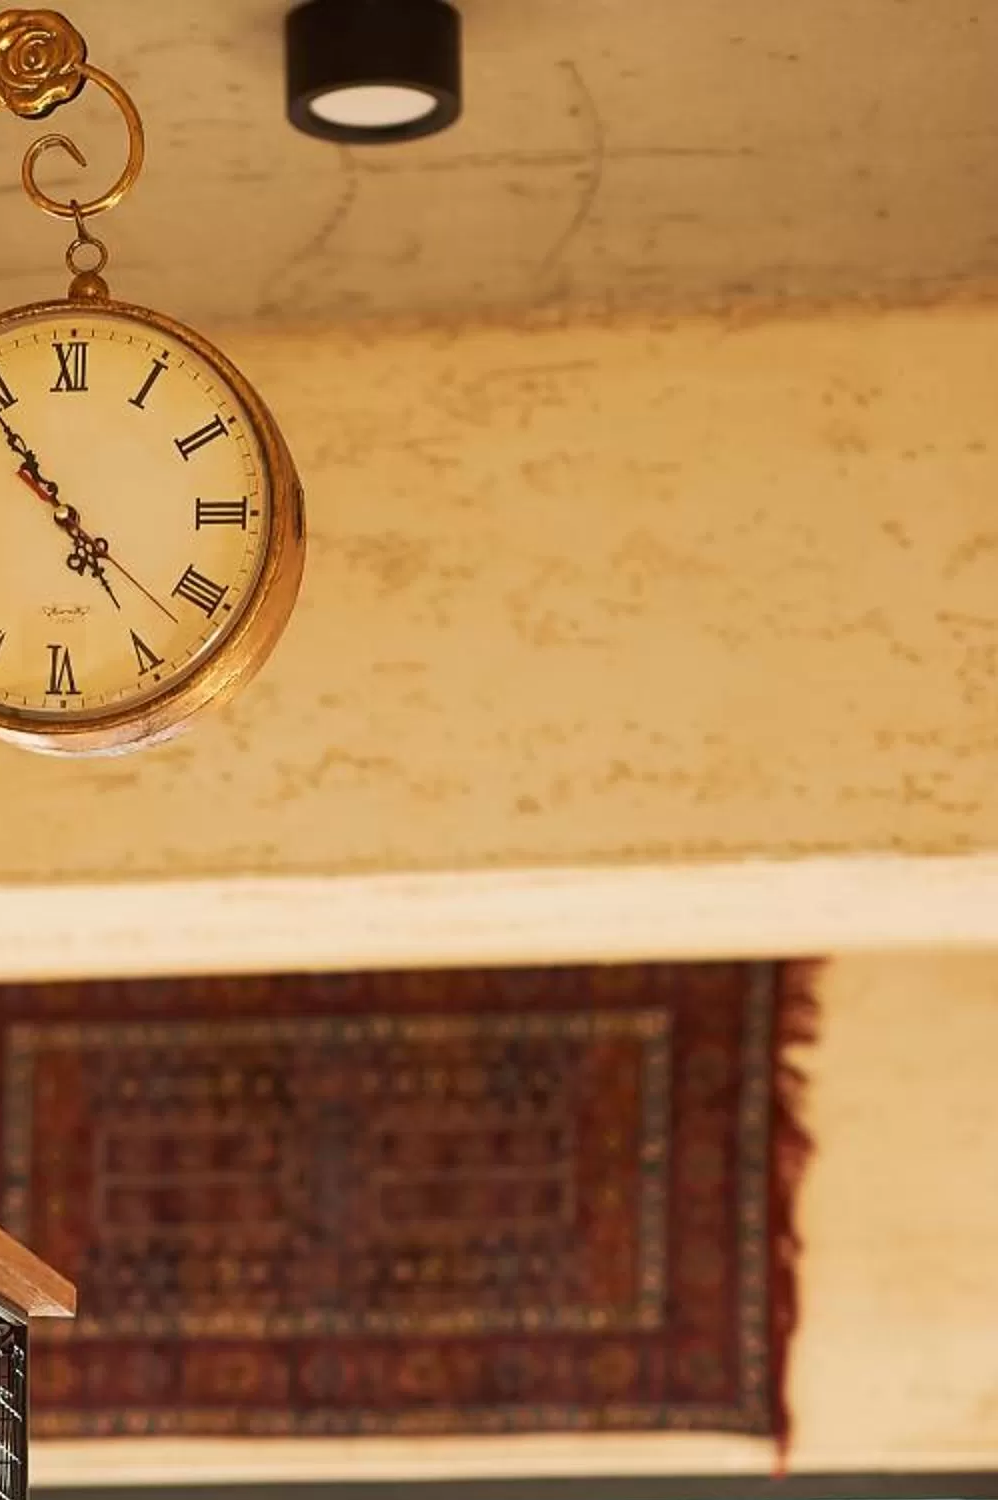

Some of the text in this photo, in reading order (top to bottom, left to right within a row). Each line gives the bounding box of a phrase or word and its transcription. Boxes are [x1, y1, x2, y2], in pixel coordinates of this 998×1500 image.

[50, 342, 88, 392] XII
[129, 357, 168, 409] I
[174, 414, 229, 460] II
[195, 497, 247, 530] III
[45, 645, 81, 695] VI
[129, 629, 165, 675] V
